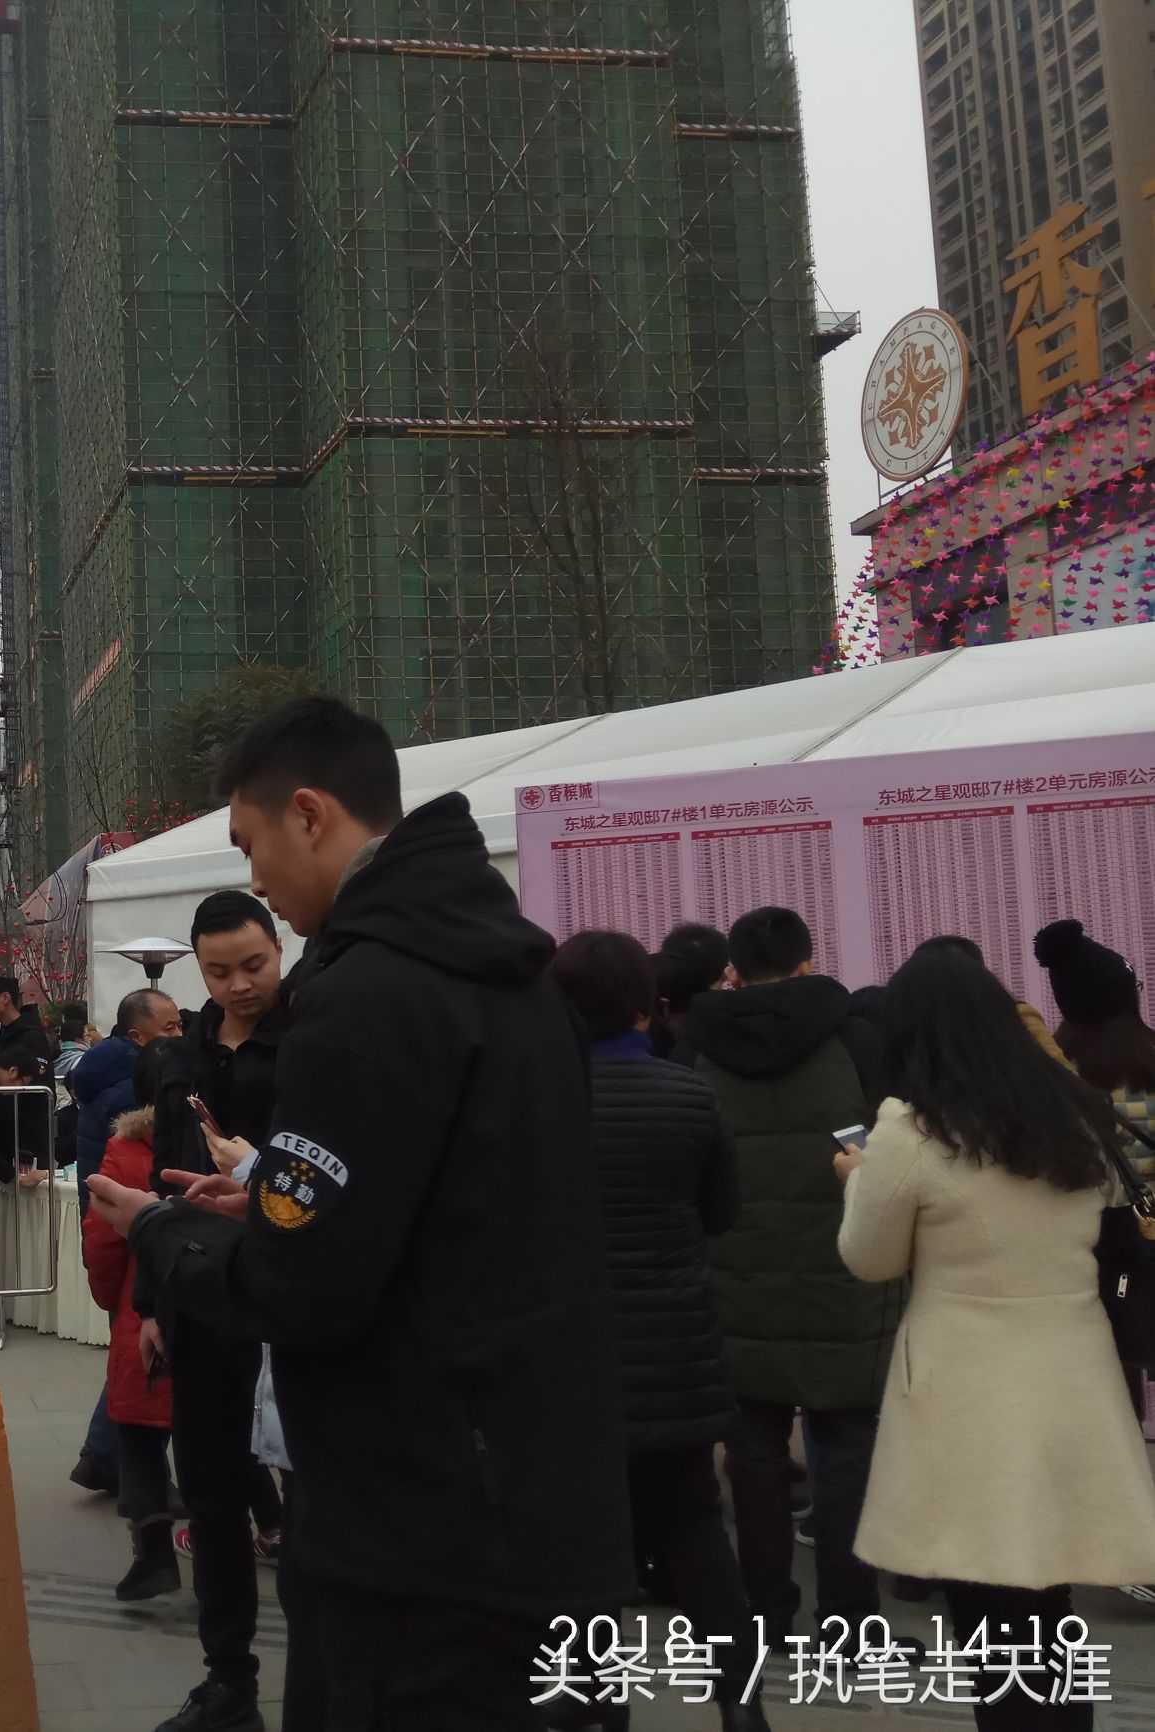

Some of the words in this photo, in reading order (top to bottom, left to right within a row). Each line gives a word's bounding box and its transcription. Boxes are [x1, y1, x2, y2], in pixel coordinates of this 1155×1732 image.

[867, 320, 956, 411] CHAMPAGNE
[564, 796, 814, 832] 东城之星观邸7#楼1单元房源公示
[281, 1134, 344, 1177] TEQIN
[274, 1171, 315, 1205] 特勤
